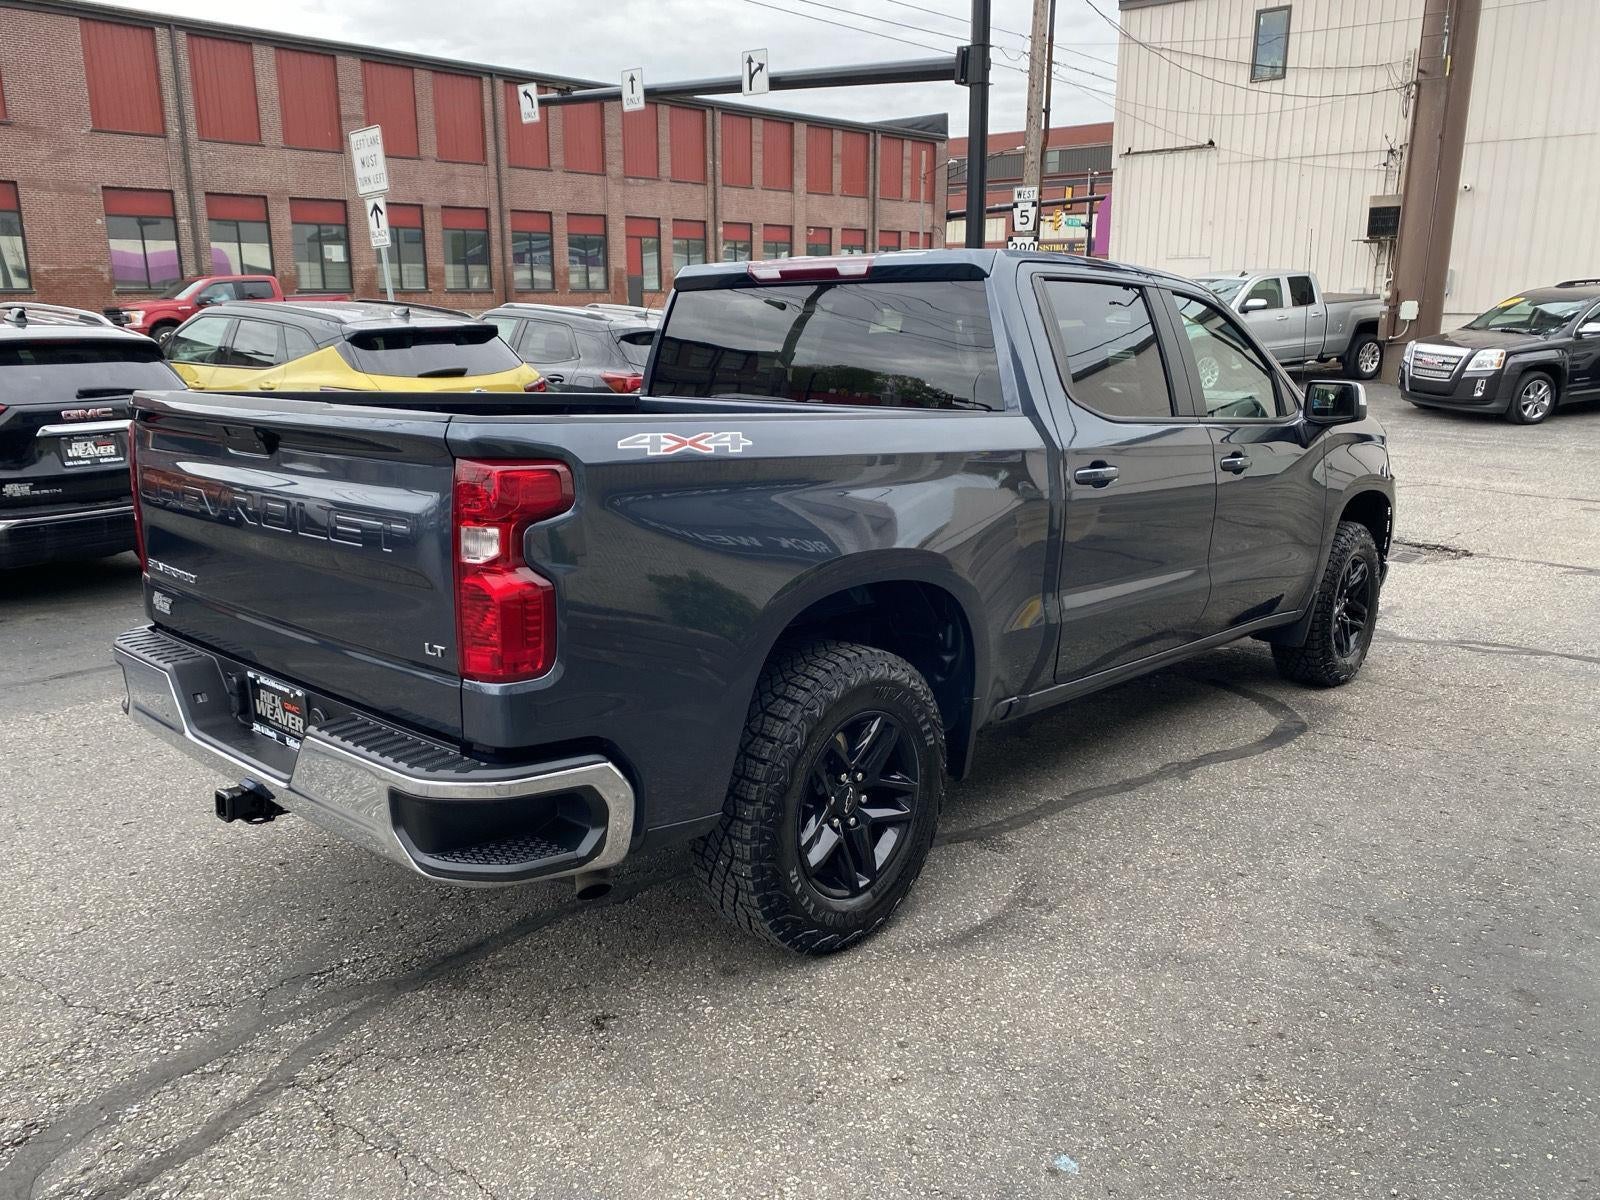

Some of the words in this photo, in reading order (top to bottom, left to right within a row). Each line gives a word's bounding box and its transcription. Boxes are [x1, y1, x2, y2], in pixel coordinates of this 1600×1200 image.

[626, 96, 641, 106] ONLY
[524, 111, 536, 120] ONLY
[353, 138, 366, 151] LEFT
[367, 135, 380, 147] LANE
[360, 154, 378, 168] MUST
[358, 175, 372, 187] TURN
[373, 172, 385, 184] LEFT
[1016, 190, 1035, 199] WEST
[1019, 209, 1030, 225] 5
[1039, 243, 1068, 251] SISTIBLE
[61, 407, 114, 420] GMC
[67, 445, 116, 457] WEAVER
[71, 441, 95, 451] RICK
[147, 557, 199, 585] SILVERADO
[424, 642, 446, 658] LT
[259, 688, 281, 707] RICK
[255, 698, 304, 734] WEAVER
